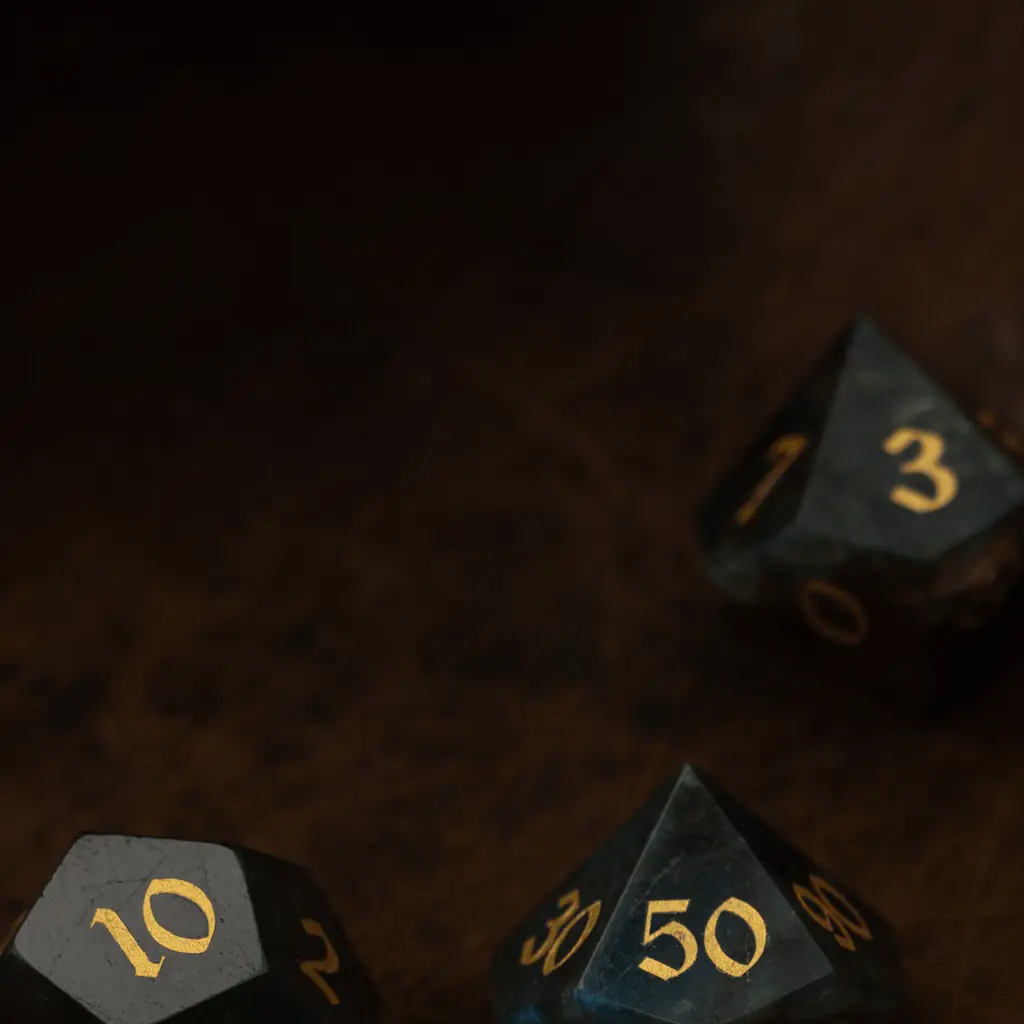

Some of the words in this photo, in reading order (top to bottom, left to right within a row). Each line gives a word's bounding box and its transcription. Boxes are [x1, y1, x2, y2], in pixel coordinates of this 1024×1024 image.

[881, 426, 959, 514] 3
[90, 878, 216, 978] 10
[520, 888, 602, 977] 30
[638, 896, 768, 981] 50
[793, 875, 874, 951] 90
[300, 917, 340, 1005] 2
